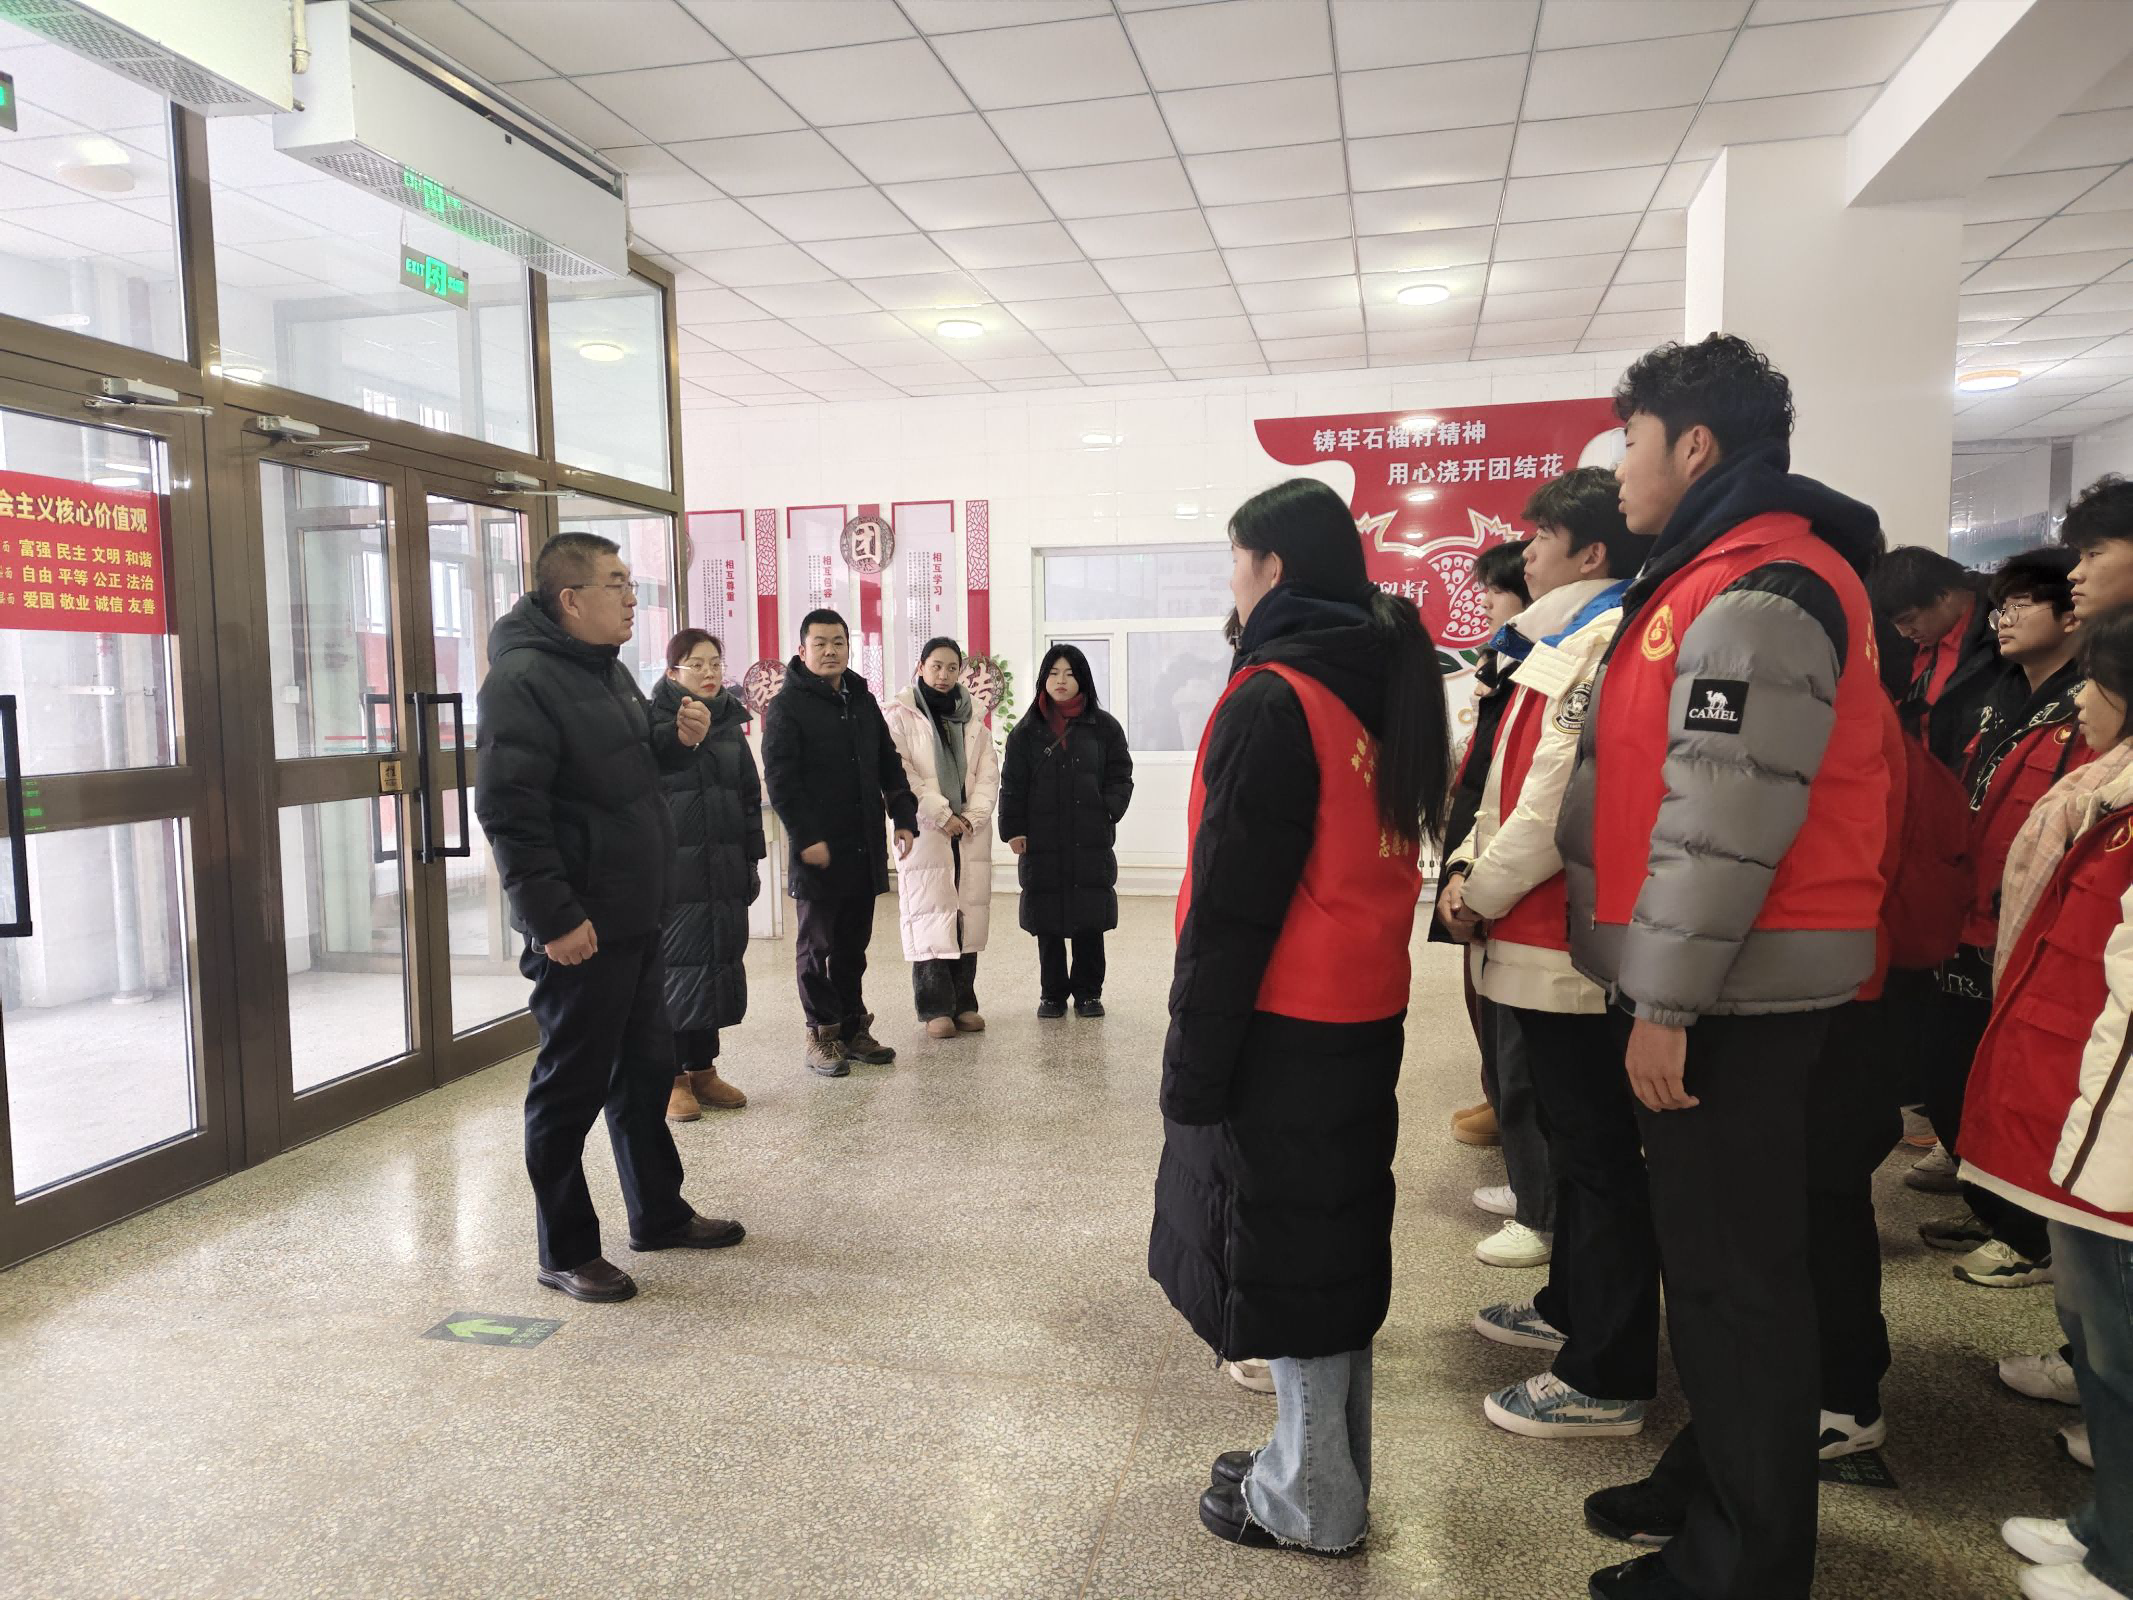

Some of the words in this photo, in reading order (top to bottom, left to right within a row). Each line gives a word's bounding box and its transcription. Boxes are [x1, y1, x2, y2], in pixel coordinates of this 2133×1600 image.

[1313, 420, 1486, 453] 铸牢石榴籽精神
[1387, 454, 1564, 486] 用心浇开团结花
[19, 539, 52, 558] 富强
[57, 543, 87, 562] 民主
[92, 546, 121, 565] 文明
[125, 551, 153, 568] 和谐
[23, 565, 53, 584] 自由
[58, 568, 89, 587] 平等
[93, 571, 123, 589] 公正
[127, 574, 154, 591] 法治
[726, 560, 735, 601] 相互尊重
[823, 556, 832, 598] 相互包容
[933, 552, 942, 595] 相互学习
[23, 591, 55, 609] 爱国
[60, 592, 91, 611] 敬业
[95, 595, 123, 613] 诚信
[128, 597, 156, 614] 友善
[1689, 709, 1738, 722] CAMEL
